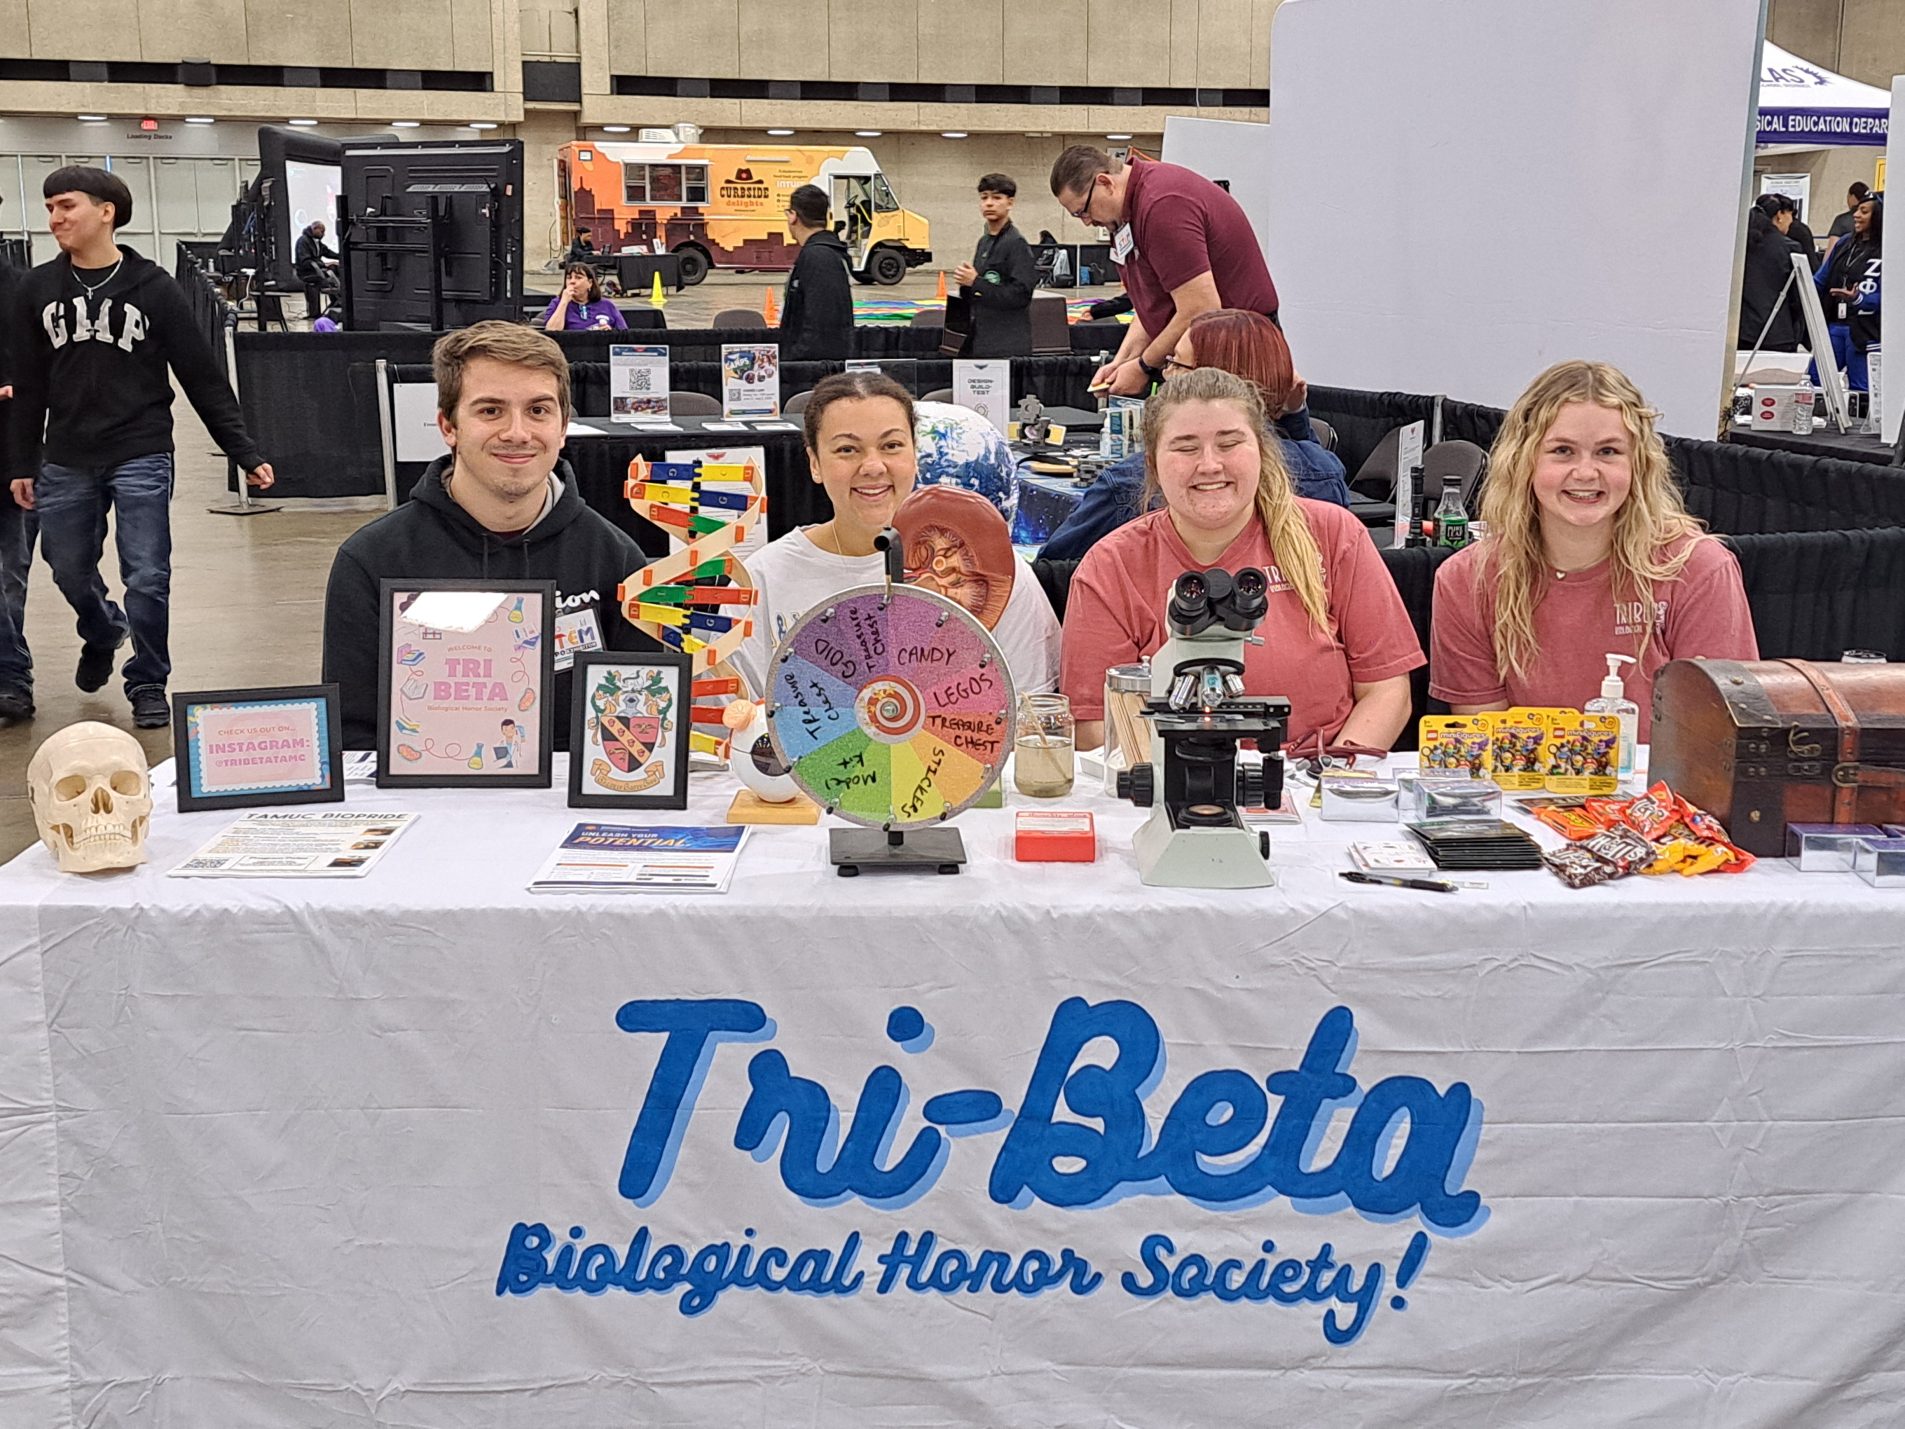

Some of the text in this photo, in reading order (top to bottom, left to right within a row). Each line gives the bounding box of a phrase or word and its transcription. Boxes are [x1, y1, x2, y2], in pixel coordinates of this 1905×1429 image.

[1788, 115, 1850, 133] EDUCATION
[1853, 117, 1888, 134] DEPAR
[720, 186, 769, 199] CURBSIDE
[726, 200, 764, 208] delights
[447, 644, 482, 652] WELCOME
[898, 647, 957, 667] CANDY
[445, 658, 493, 678] TRI
[433, 681, 509, 701] BETA
[933, 673, 993, 708] LEGOS
[427, 704, 460, 712] Biological
[484, 705, 508, 713] Society
[218, 728, 245, 736] CHECK
[259, 726, 275, 734] OUT
[927, 714, 995, 735] TREASURE
[208, 738, 311, 755] INSTAGRAM:
[953, 735, 1000, 754] CHEST
[215, 753, 306, 767] @TRIBETATAMC
[901, 747, 945, 818] STICKERS
[321, 812, 409, 820] BIOPRIDE
[615, 996, 1492, 1239] Tri-Beta
[496, 1222, 1432, 1348] Biological Honor Society!
